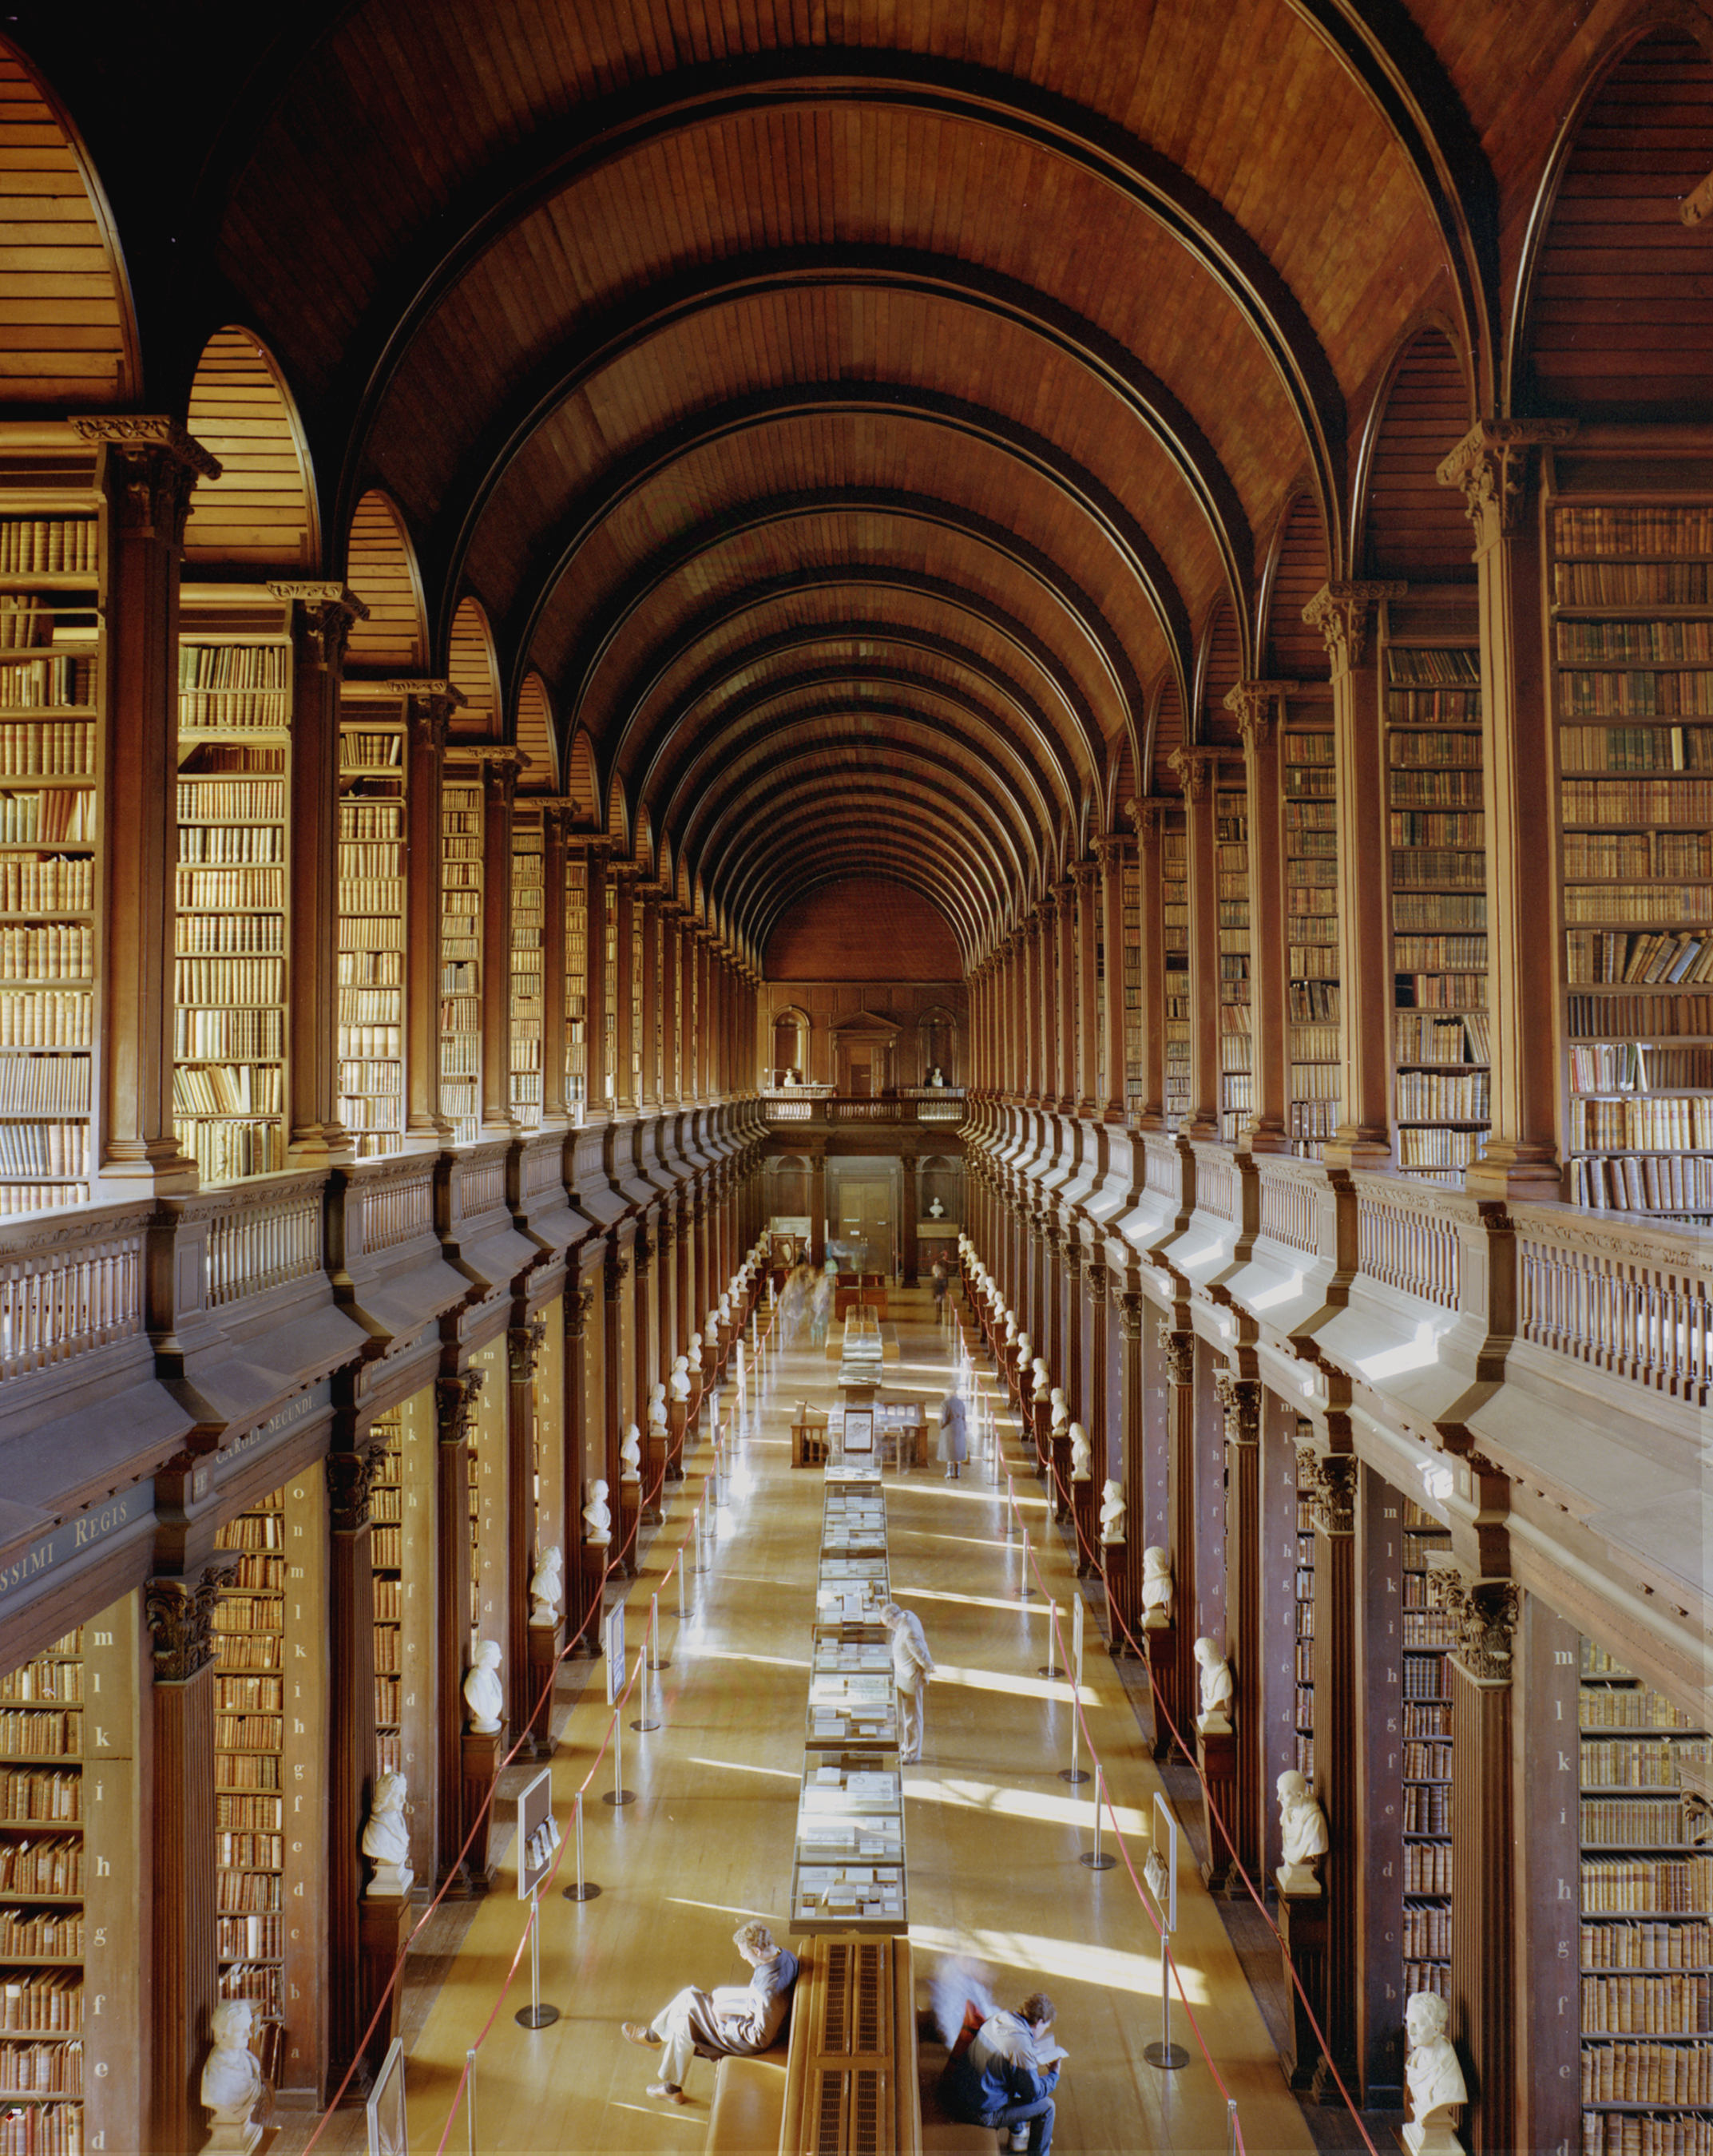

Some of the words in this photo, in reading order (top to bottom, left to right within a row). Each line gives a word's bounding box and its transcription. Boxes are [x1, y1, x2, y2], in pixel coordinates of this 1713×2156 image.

[409, 1402, 413, 1414] l
[408, 1428, 417, 1441] k
[409, 1459, 413, 1472] i
[293, 1488, 304, 1499] o
[408, 1493, 417, 1507] h
[1384, 1508, 1398, 1518] m
[294, 1526, 302, 1536] n
[1388, 1543, 1392, 1557] l
[291, 1567, 303, 1578] m
[1386, 1577, 1397, 1592] k
[295, 1604, 300, 1619] l
[1389, 1620, 1394, 1634] i
[93, 1632, 113, 1646] m
[295, 1644, 307, 1657] k
[406, 1643, 414, 1652] e
[1554, 1651, 1573, 1665] m
[1387, 1667, 1398, 1682] h
[93, 1674, 100, 1693] l
[295, 1681, 300, 1698] i
[406, 1693, 414, 1706] d
[1556, 1701, 1563, 1720] l
[294, 1718, 304, 1734] h
[1387, 1718, 1397, 1732] g
[95, 1726, 109, 1746] k
[406, 1753, 414, 1762] c
[1557, 1751, 1570, 1770] k
[294, 1765, 304, 1780] g
[96, 1781, 103, 1801] i
[294, 1795, 303, 1812] f
[406, 1801, 414, 1814] b
[1385, 1805, 1394, 1814] e
[1560, 1808, 1565, 1824] i
[292, 1842, 302, 1853] e
[96, 1856, 109, 1877] h
[1382, 1861, 1393, 1877] d
[294, 1882, 303, 1896] d
[1557, 1878, 1571, 1900] h
[93, 1928, 107, 1946] g
[291, 1929, 299, 1939] c
[1385, 1932, 1394, 1941] c
[1558, 1940, 1569, 1958] g
[290, 1983, 299, 1999] b
[1386, 1984, 1396, 1999] b
[93, 1995, 105, 2015] f
[291, 2048, 299, 2059] a
[94, 2063, 108, 2077] e
[1559, 2065, 1571, 2079] e
[92, 2130, 105, 2150] d
[1556, 2138, 1568, 2156] d
